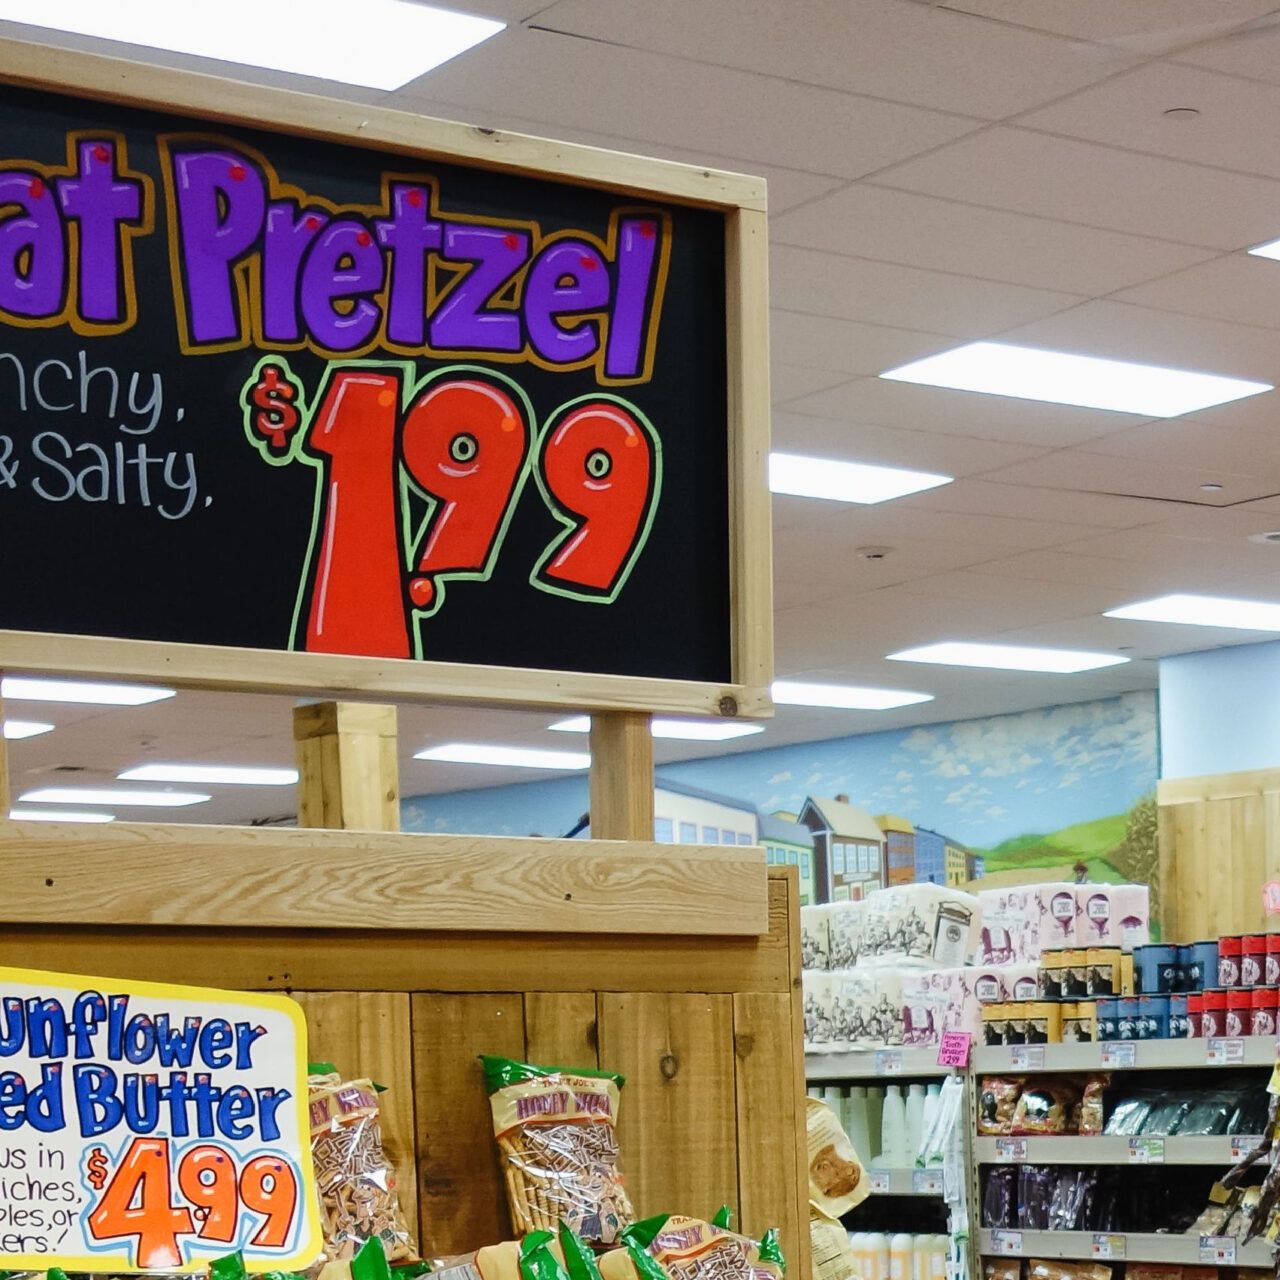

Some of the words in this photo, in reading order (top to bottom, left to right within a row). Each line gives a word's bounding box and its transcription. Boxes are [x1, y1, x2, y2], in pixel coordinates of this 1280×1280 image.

[160, 136, 670, 384] Pretzel
[32, 431, 213, 520] Salty,
[0, 990, 268, 1070] unflower
[72, 1063, 292, 1142] Butter
[38, 1142, 64, 1170] in
